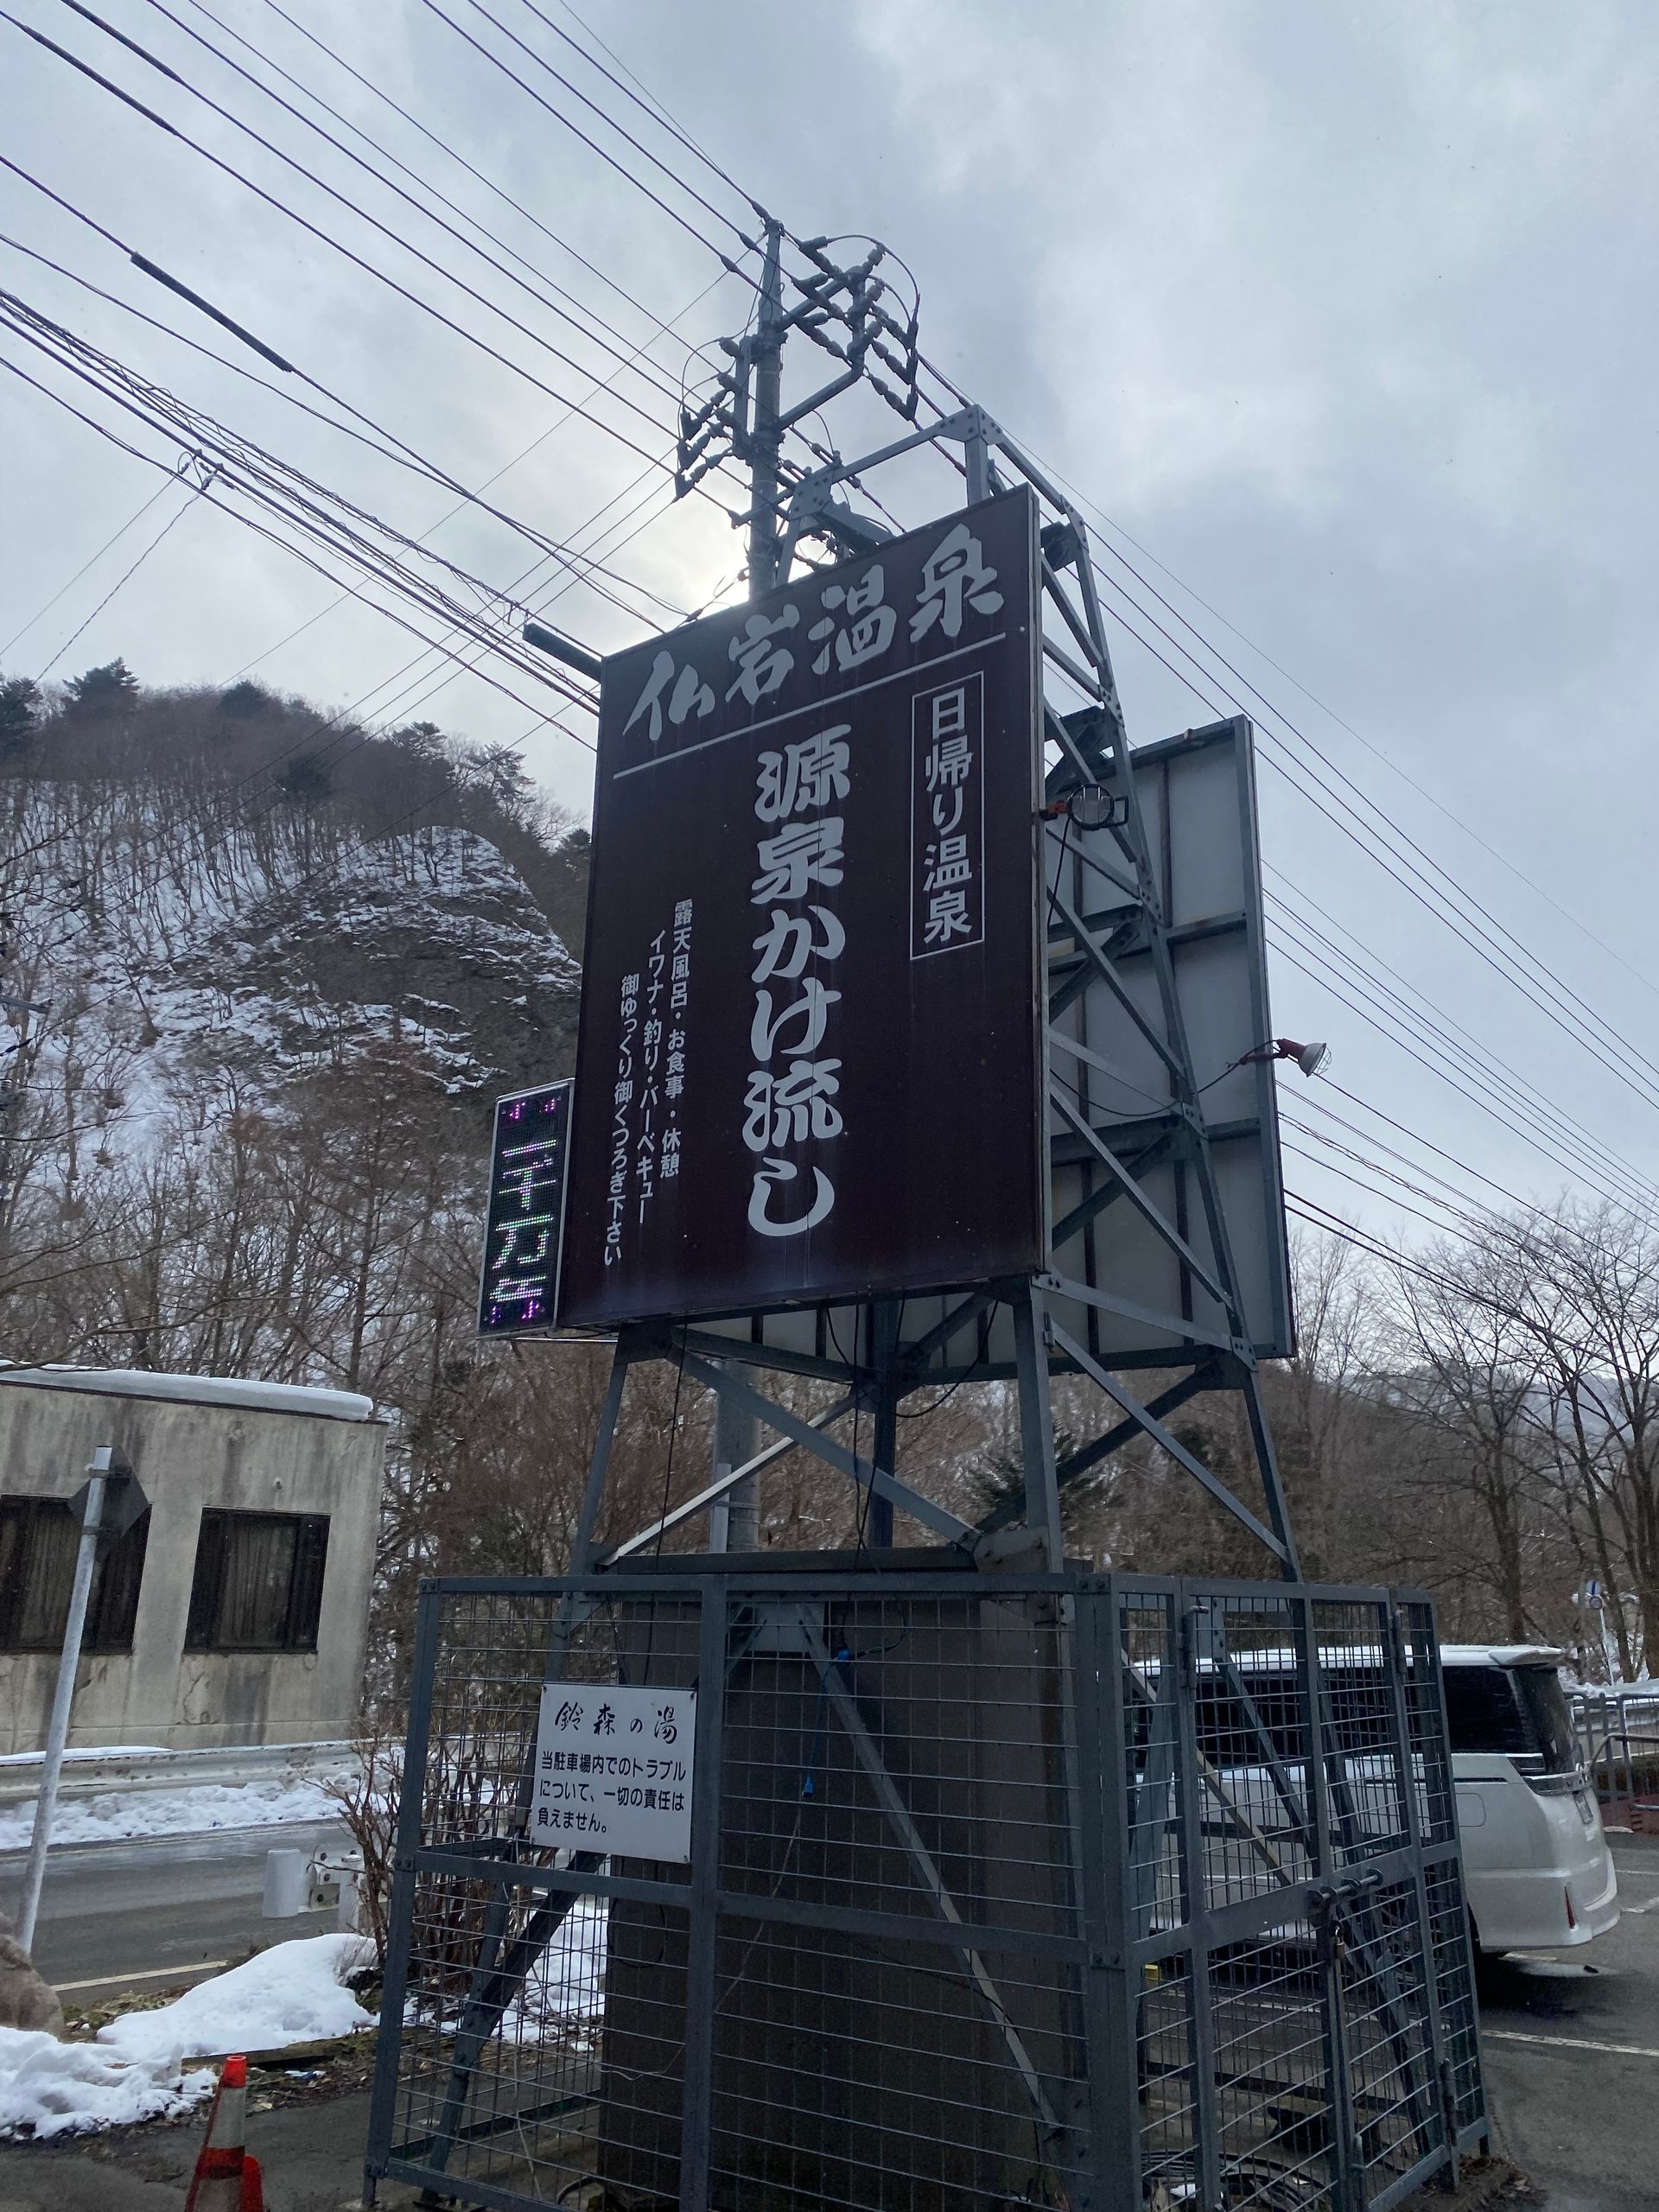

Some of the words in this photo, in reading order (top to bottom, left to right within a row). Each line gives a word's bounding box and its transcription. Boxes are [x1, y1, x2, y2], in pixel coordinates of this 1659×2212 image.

[622, 523, 1005, 741] 仏岩温泉
[922, 687, 973, 944] 日帰り温泉
[635, 929, 666, 1224] イワナ・釣り・バーベキュー
[742, 723, 851, 1236] 源泉かけ流し
[604, 973, 640, 1266] 御ゆっくり御くつろぎ下さい
[537, 1807, 607, 1834] 負えません。
[539, 1778, 685, 1811] について、一切の責任は
[541, 1750, 687, 1782] 当駐車場内でのトラブル
[555, 1700, 678, 1745] 鈴森の湯
